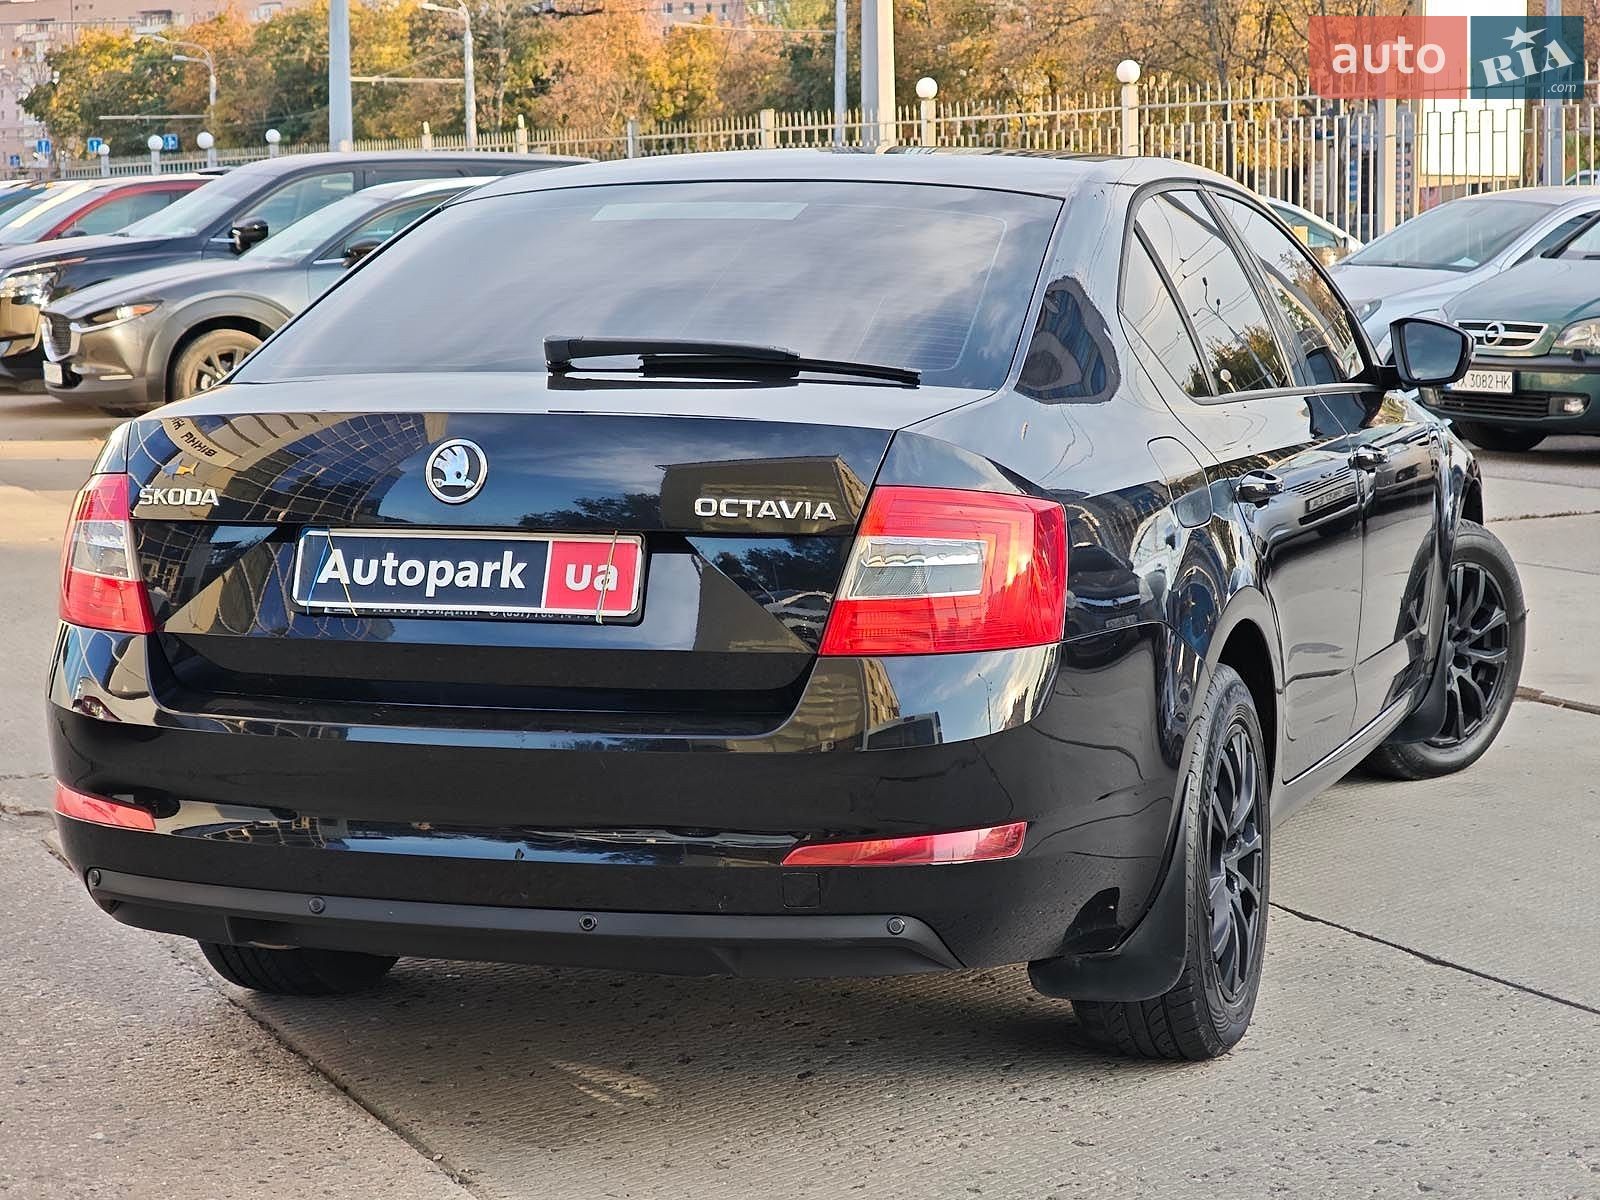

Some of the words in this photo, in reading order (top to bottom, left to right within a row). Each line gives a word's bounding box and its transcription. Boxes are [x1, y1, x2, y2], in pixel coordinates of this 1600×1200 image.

[1470, 373, 1494, 389] 3082
[1495, 374, 1511, 389] HK
[138, 484, 220, 506] ŠKODA
[694, 497, 837, 521] OCTAVIA
[316, 548, 528, 598] Autopark
[565, 562, 619, 592] ua
